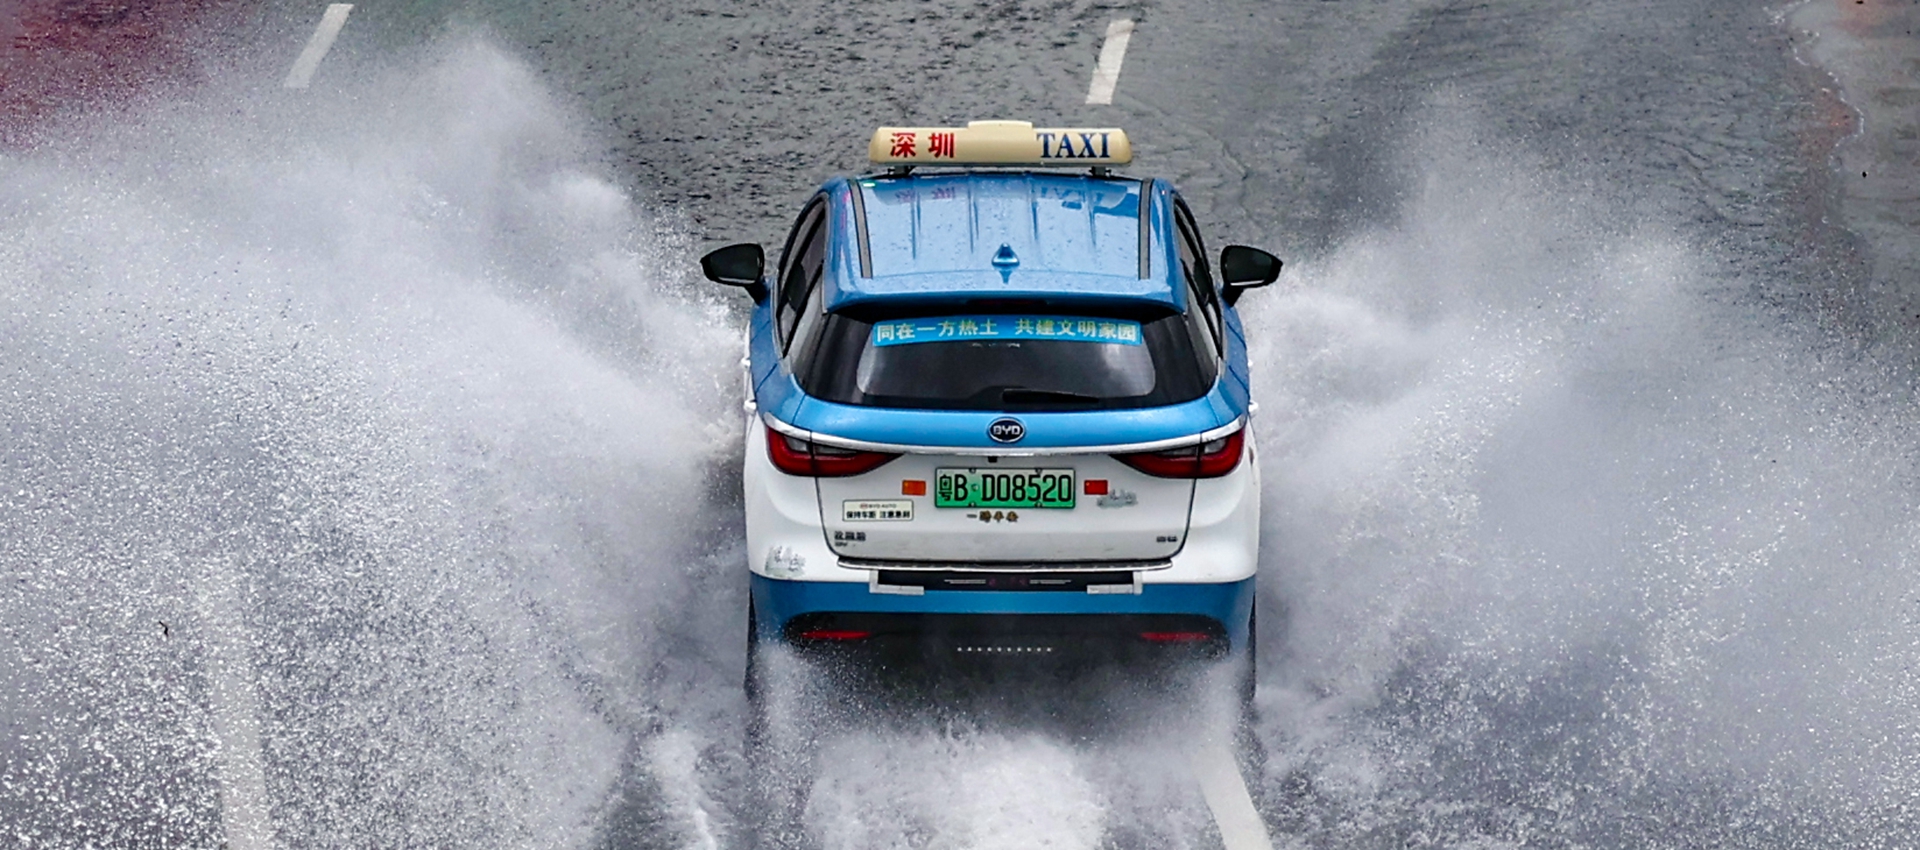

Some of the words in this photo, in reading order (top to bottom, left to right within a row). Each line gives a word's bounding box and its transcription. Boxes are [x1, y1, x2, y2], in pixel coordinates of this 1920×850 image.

[890, 132, 954, 158] 深圳
[1036, 133, 1111, 158] TAXI
[877, 319, 999, 342] 同在一方热土
[1015, 318, 1138, 342] 共建文明家园
[993, 425, 1021, 435] BYD
